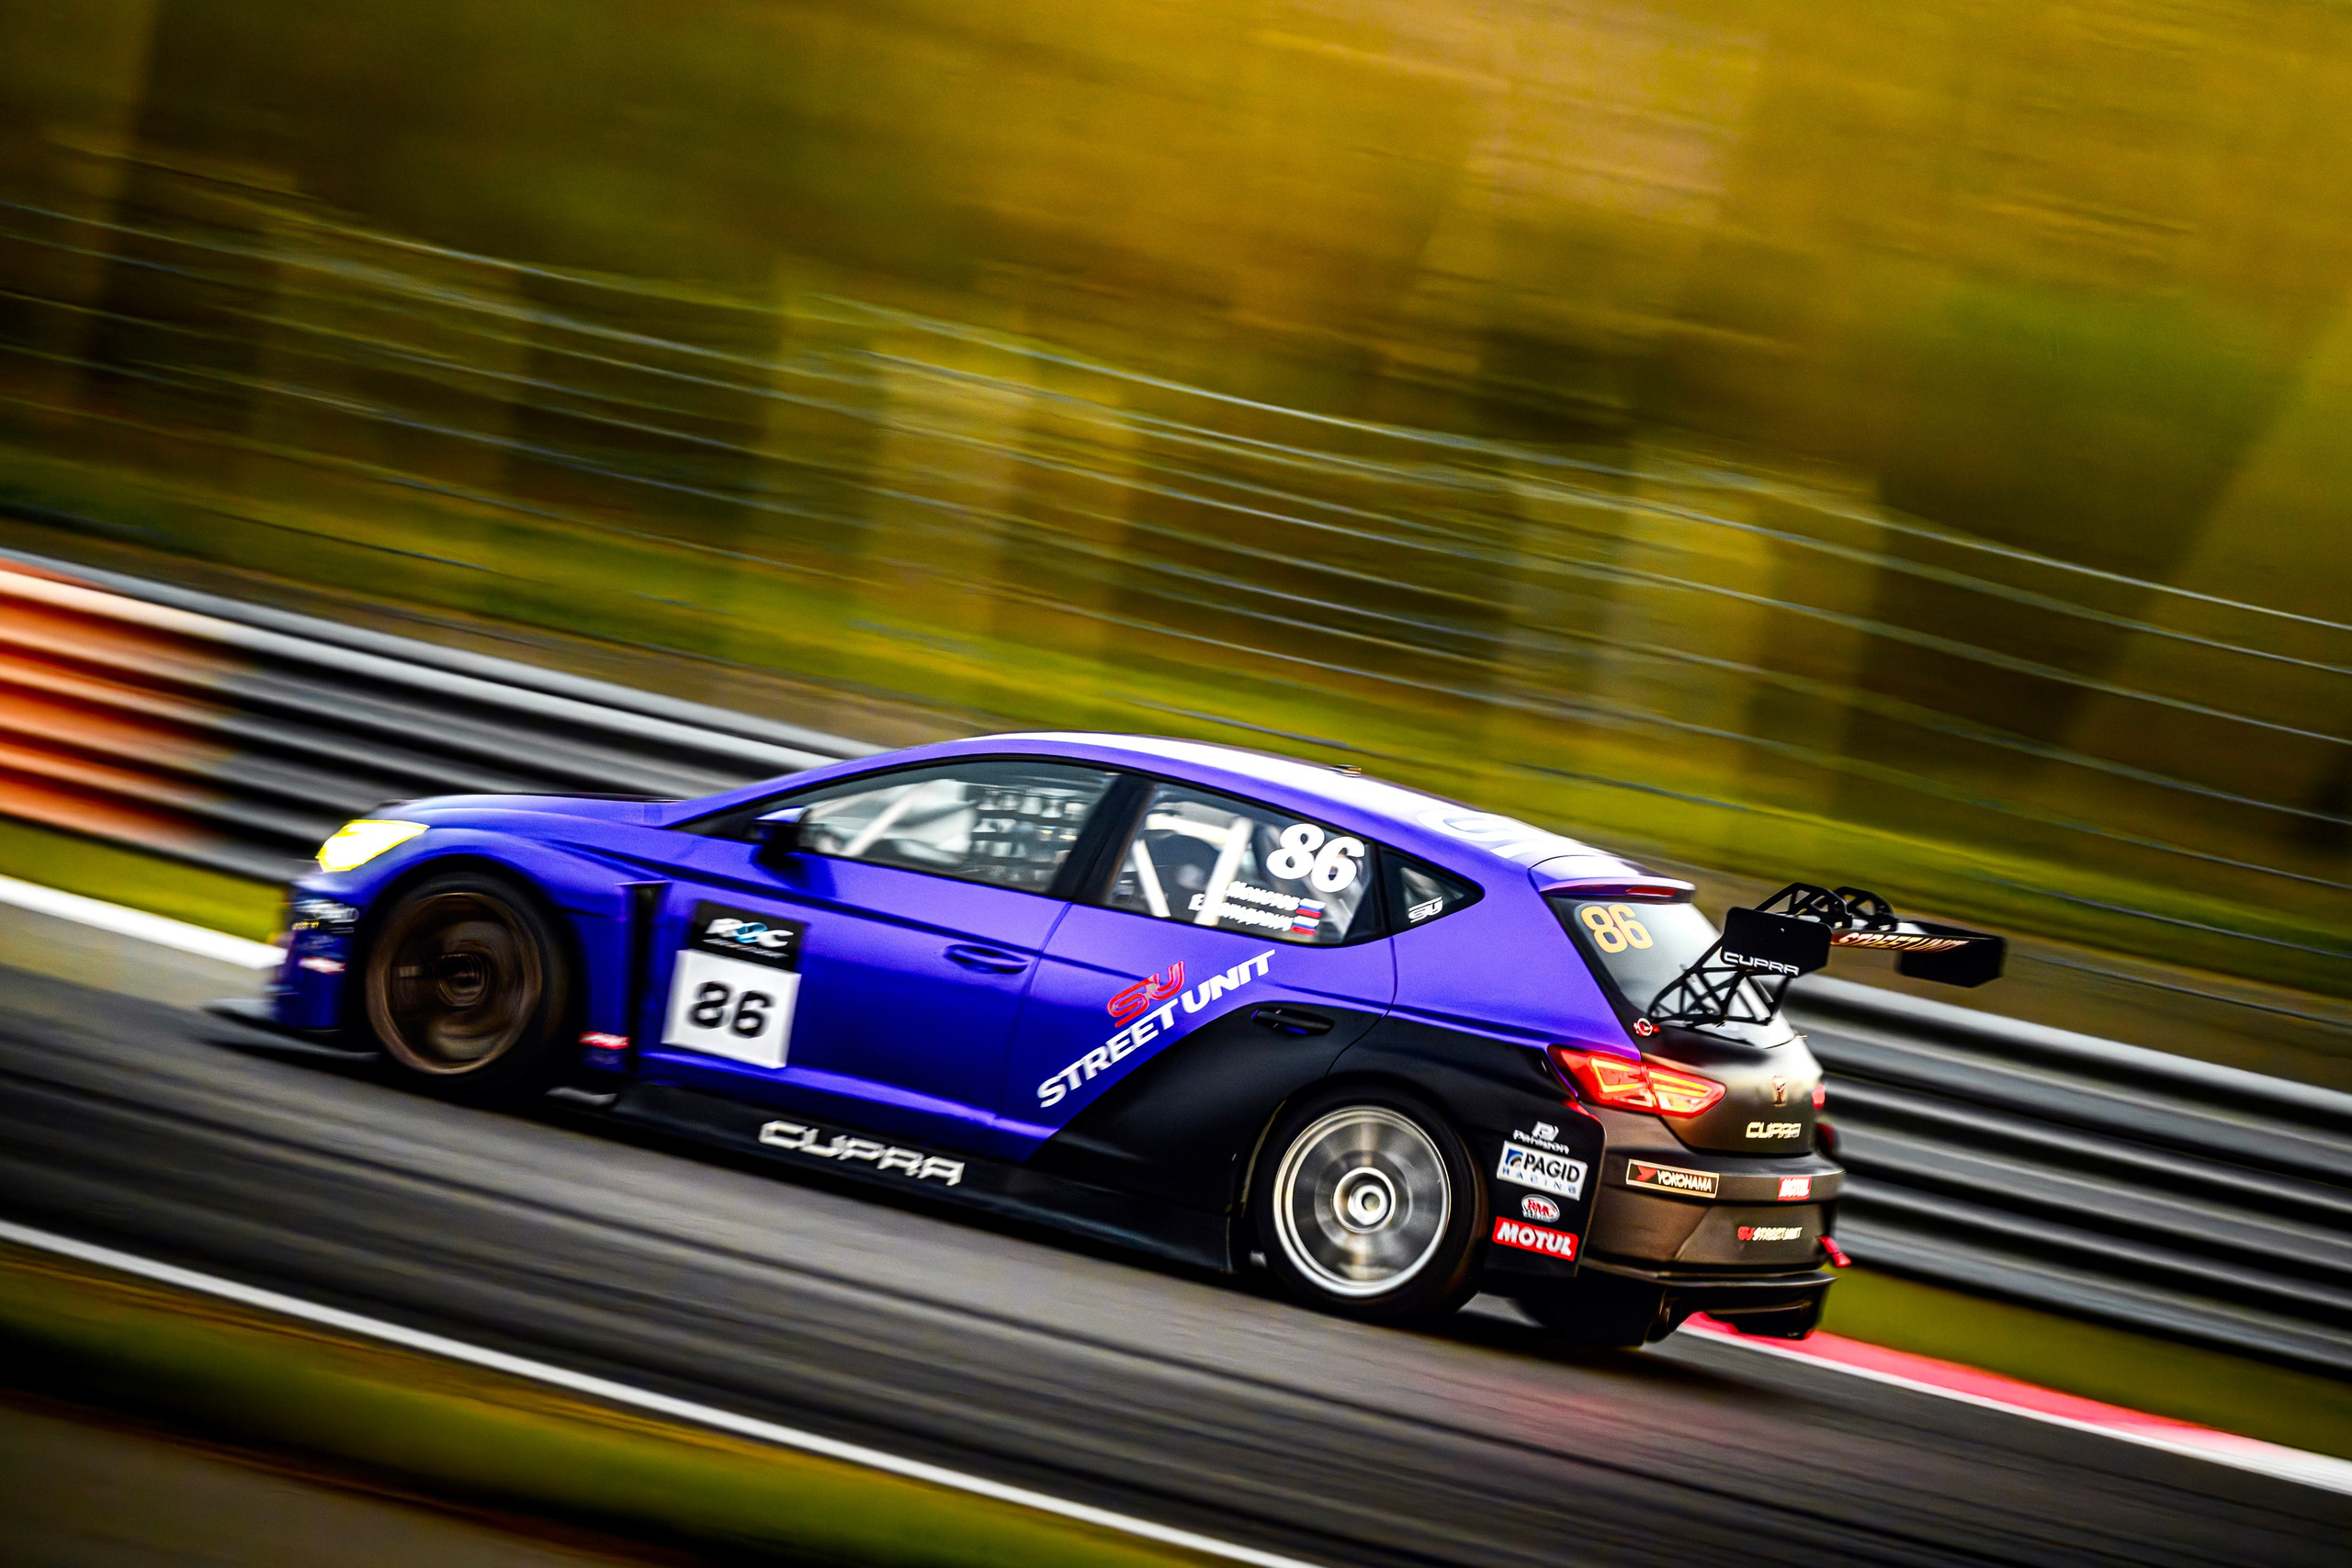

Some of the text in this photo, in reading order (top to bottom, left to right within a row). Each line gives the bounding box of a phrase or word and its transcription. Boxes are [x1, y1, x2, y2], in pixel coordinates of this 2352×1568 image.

[1266, 823, 1365, 893] 86
[1580, 903, 1654, 953] 86
[1724, 951, 1800, 976] CUPRA
[689, 980, 776, 1039] 86
[1106, 961, 1185, 1028] SU
[1036, 949, 1275, 1108] STREET UNIT
[758, 1120, 965, 1187] CUPRA
[1746, 1122, 1802, 1139] CUPRA
[1523, 1153, 1580, 1183] PAGID
[1657, 1169, 1713, 1193] YOKOHAMA
[1497, 1221, 1572, 1257] MOTUL
